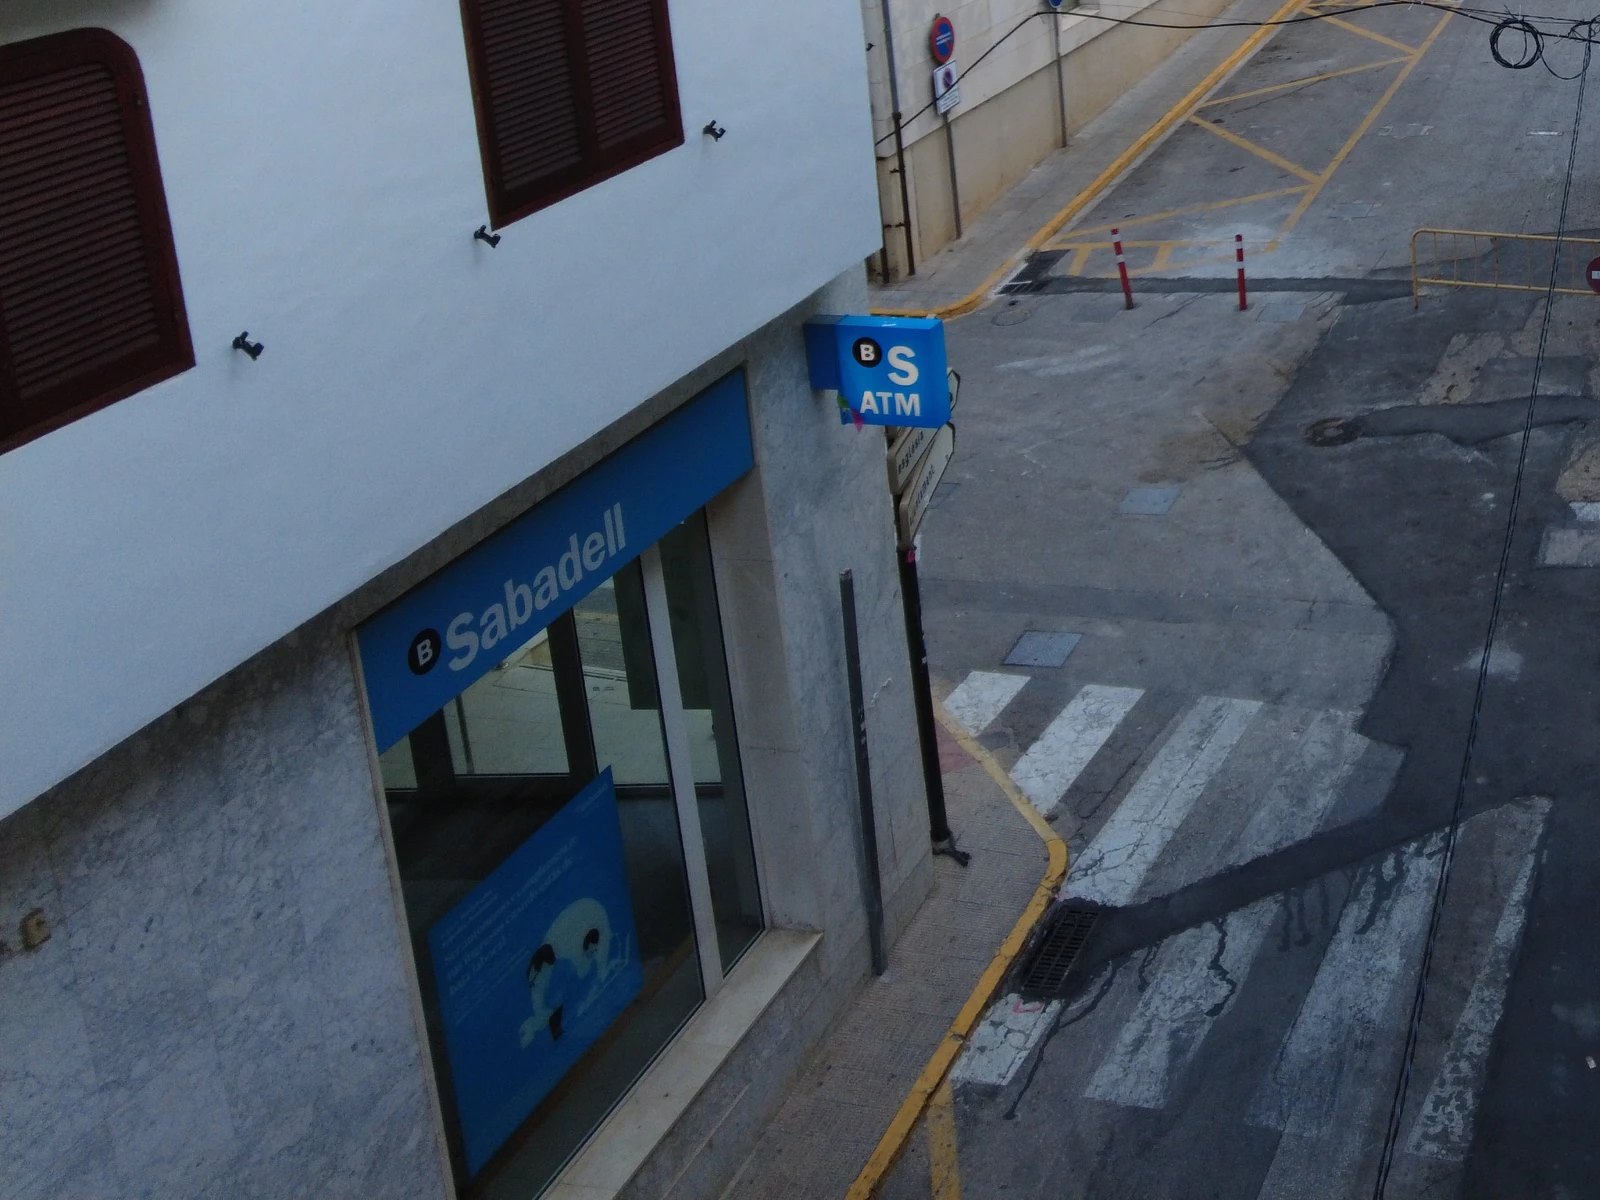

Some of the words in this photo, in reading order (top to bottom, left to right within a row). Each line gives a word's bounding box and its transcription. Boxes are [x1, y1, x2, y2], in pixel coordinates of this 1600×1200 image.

[859, 344, 875, 361] B
[887, 345, 919, 386] S
[859, 390, 921, 416] ATM
[446, 502, 626, 672] Sabadell
